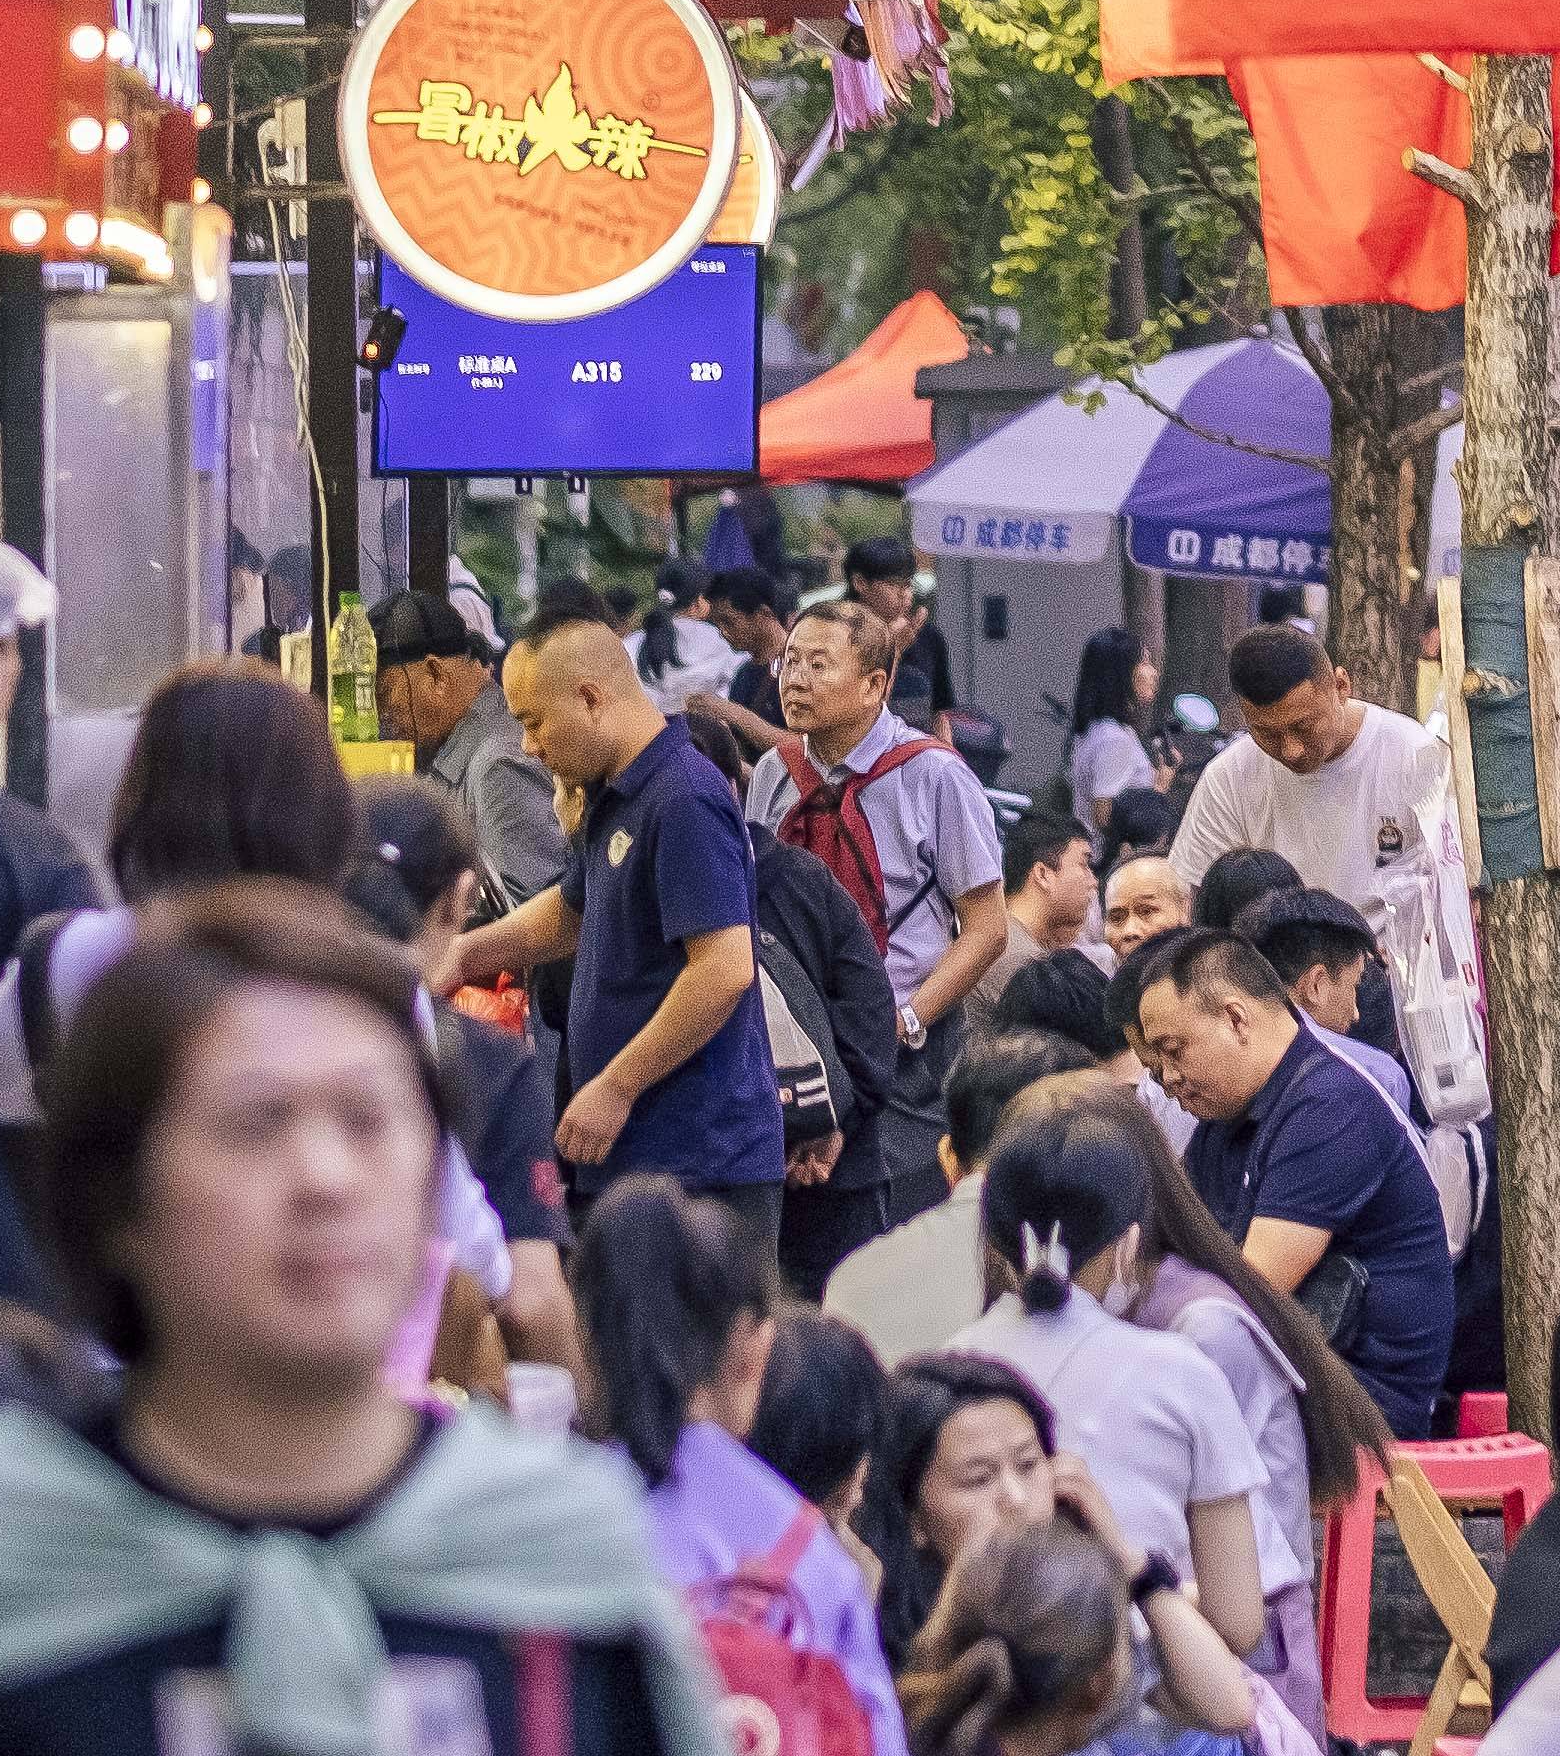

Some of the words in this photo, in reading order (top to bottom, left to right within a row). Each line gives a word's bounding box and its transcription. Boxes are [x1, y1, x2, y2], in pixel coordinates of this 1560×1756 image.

[570, 360, 623, 383] A315
[976, 516, 1073, 551] 成都停车
